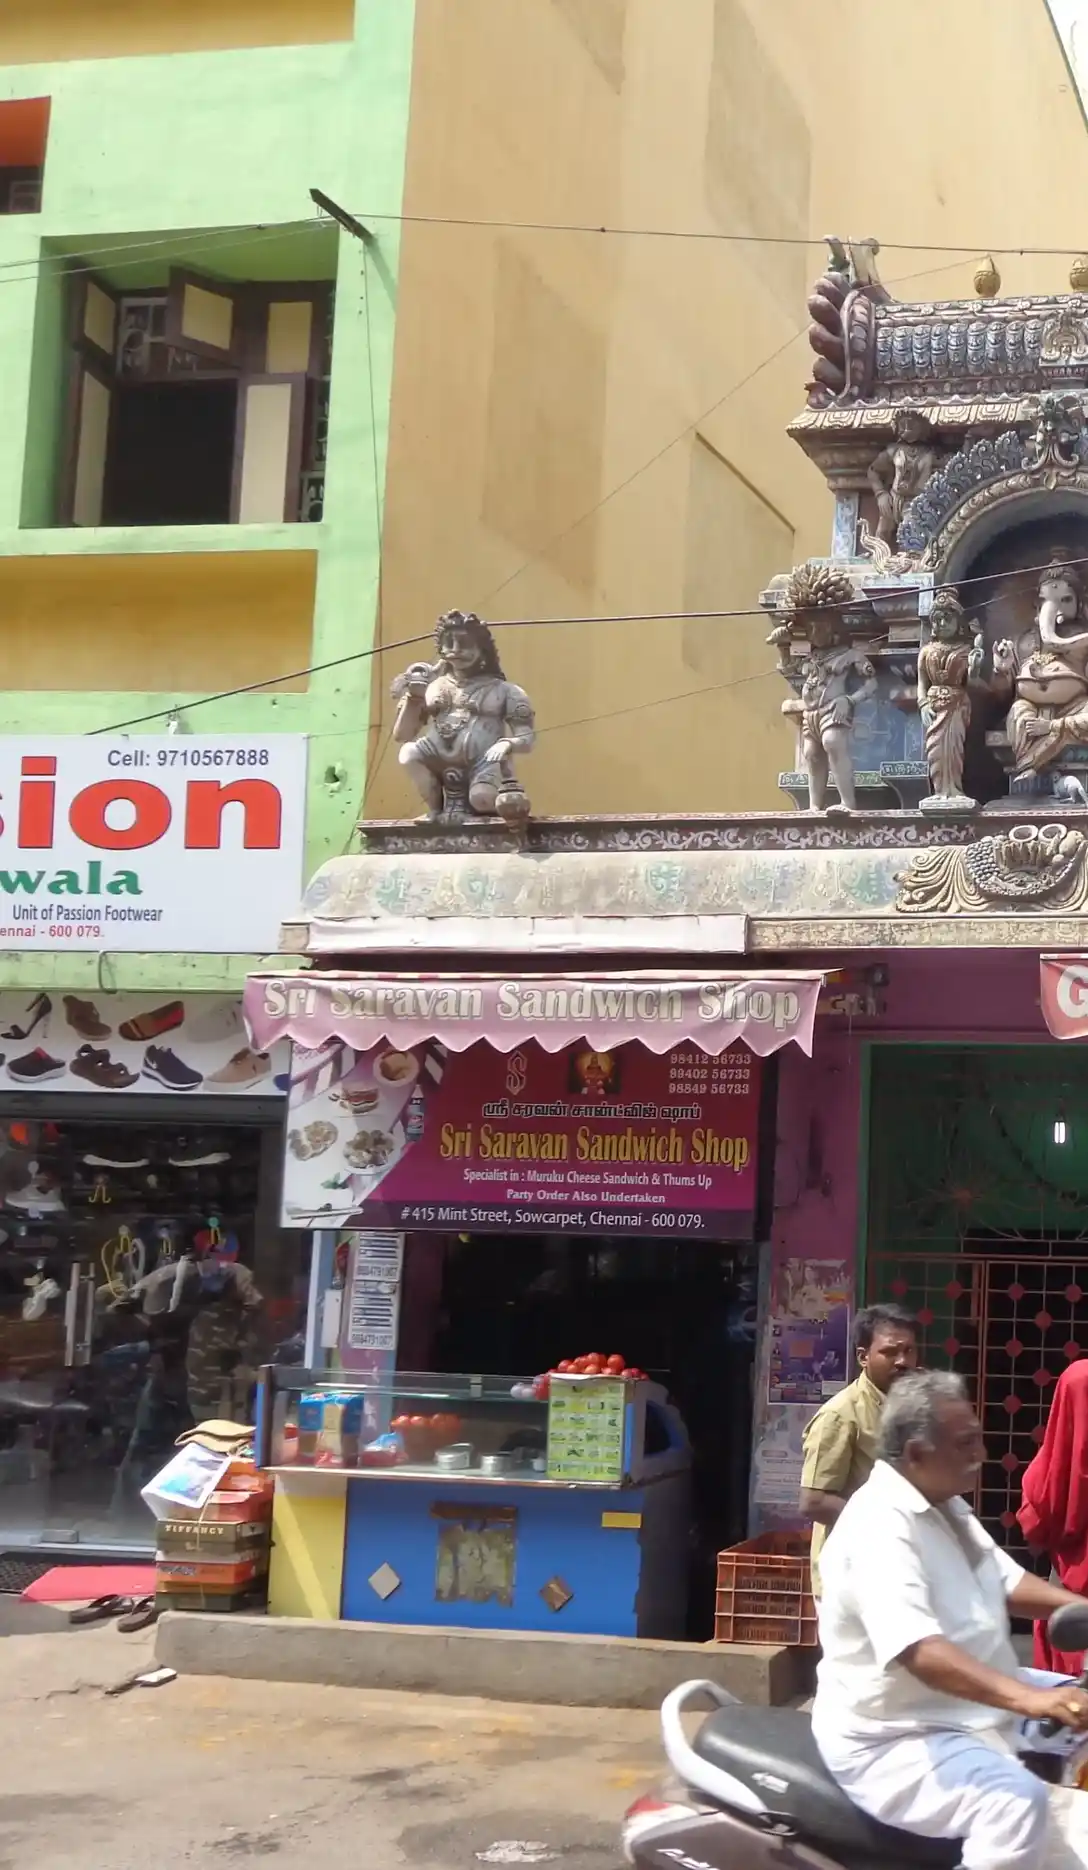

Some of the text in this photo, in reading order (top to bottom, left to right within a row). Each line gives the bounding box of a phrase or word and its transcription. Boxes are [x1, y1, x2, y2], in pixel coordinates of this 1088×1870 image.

[107, 749, 269, 766] Cell: 9710567888
[0, 756, 282, 850] ion
[13, 904, 163, 922] Unit of Passion Footwear
[49, 925, 72, 937] 600
[263, 980, 801, 1032] Sri Saravan Sandwich Shop
[712, 1054, 752, 1065] 56733
[711, 1069, 750, 1080] 56733
[710, 1084, 749, 1095] 56733
[440, 1123, 750, 1174] Sri Saravan Sandwich Shop
[463, 1168, 508, 1183] Specialist
[510, 1169, 519, 1181] in
[527, 1170, 564, 1183] Muruku
[567, 1171, 600, 1184] Cheese
[603, 1172, 649, 1185] Sandwich
[651, 1173, 660, 1185] &
[663, 1174, 695, 1186] Thums
[698, 1174, 712, 1190] Up
[506, 1189, 665, 1203] Party Order Also Undertaken
[438, 1207, 467, 1221] Mint
[470, 1208, 511, 1225] Street,
[515, 1209, 586, 1228] Sowcarpet,
[590, 1211, 642, 1226] Chennai
[652, 1213, 674, 1227] 600
[678, 1214, 705, 1229] 079.
